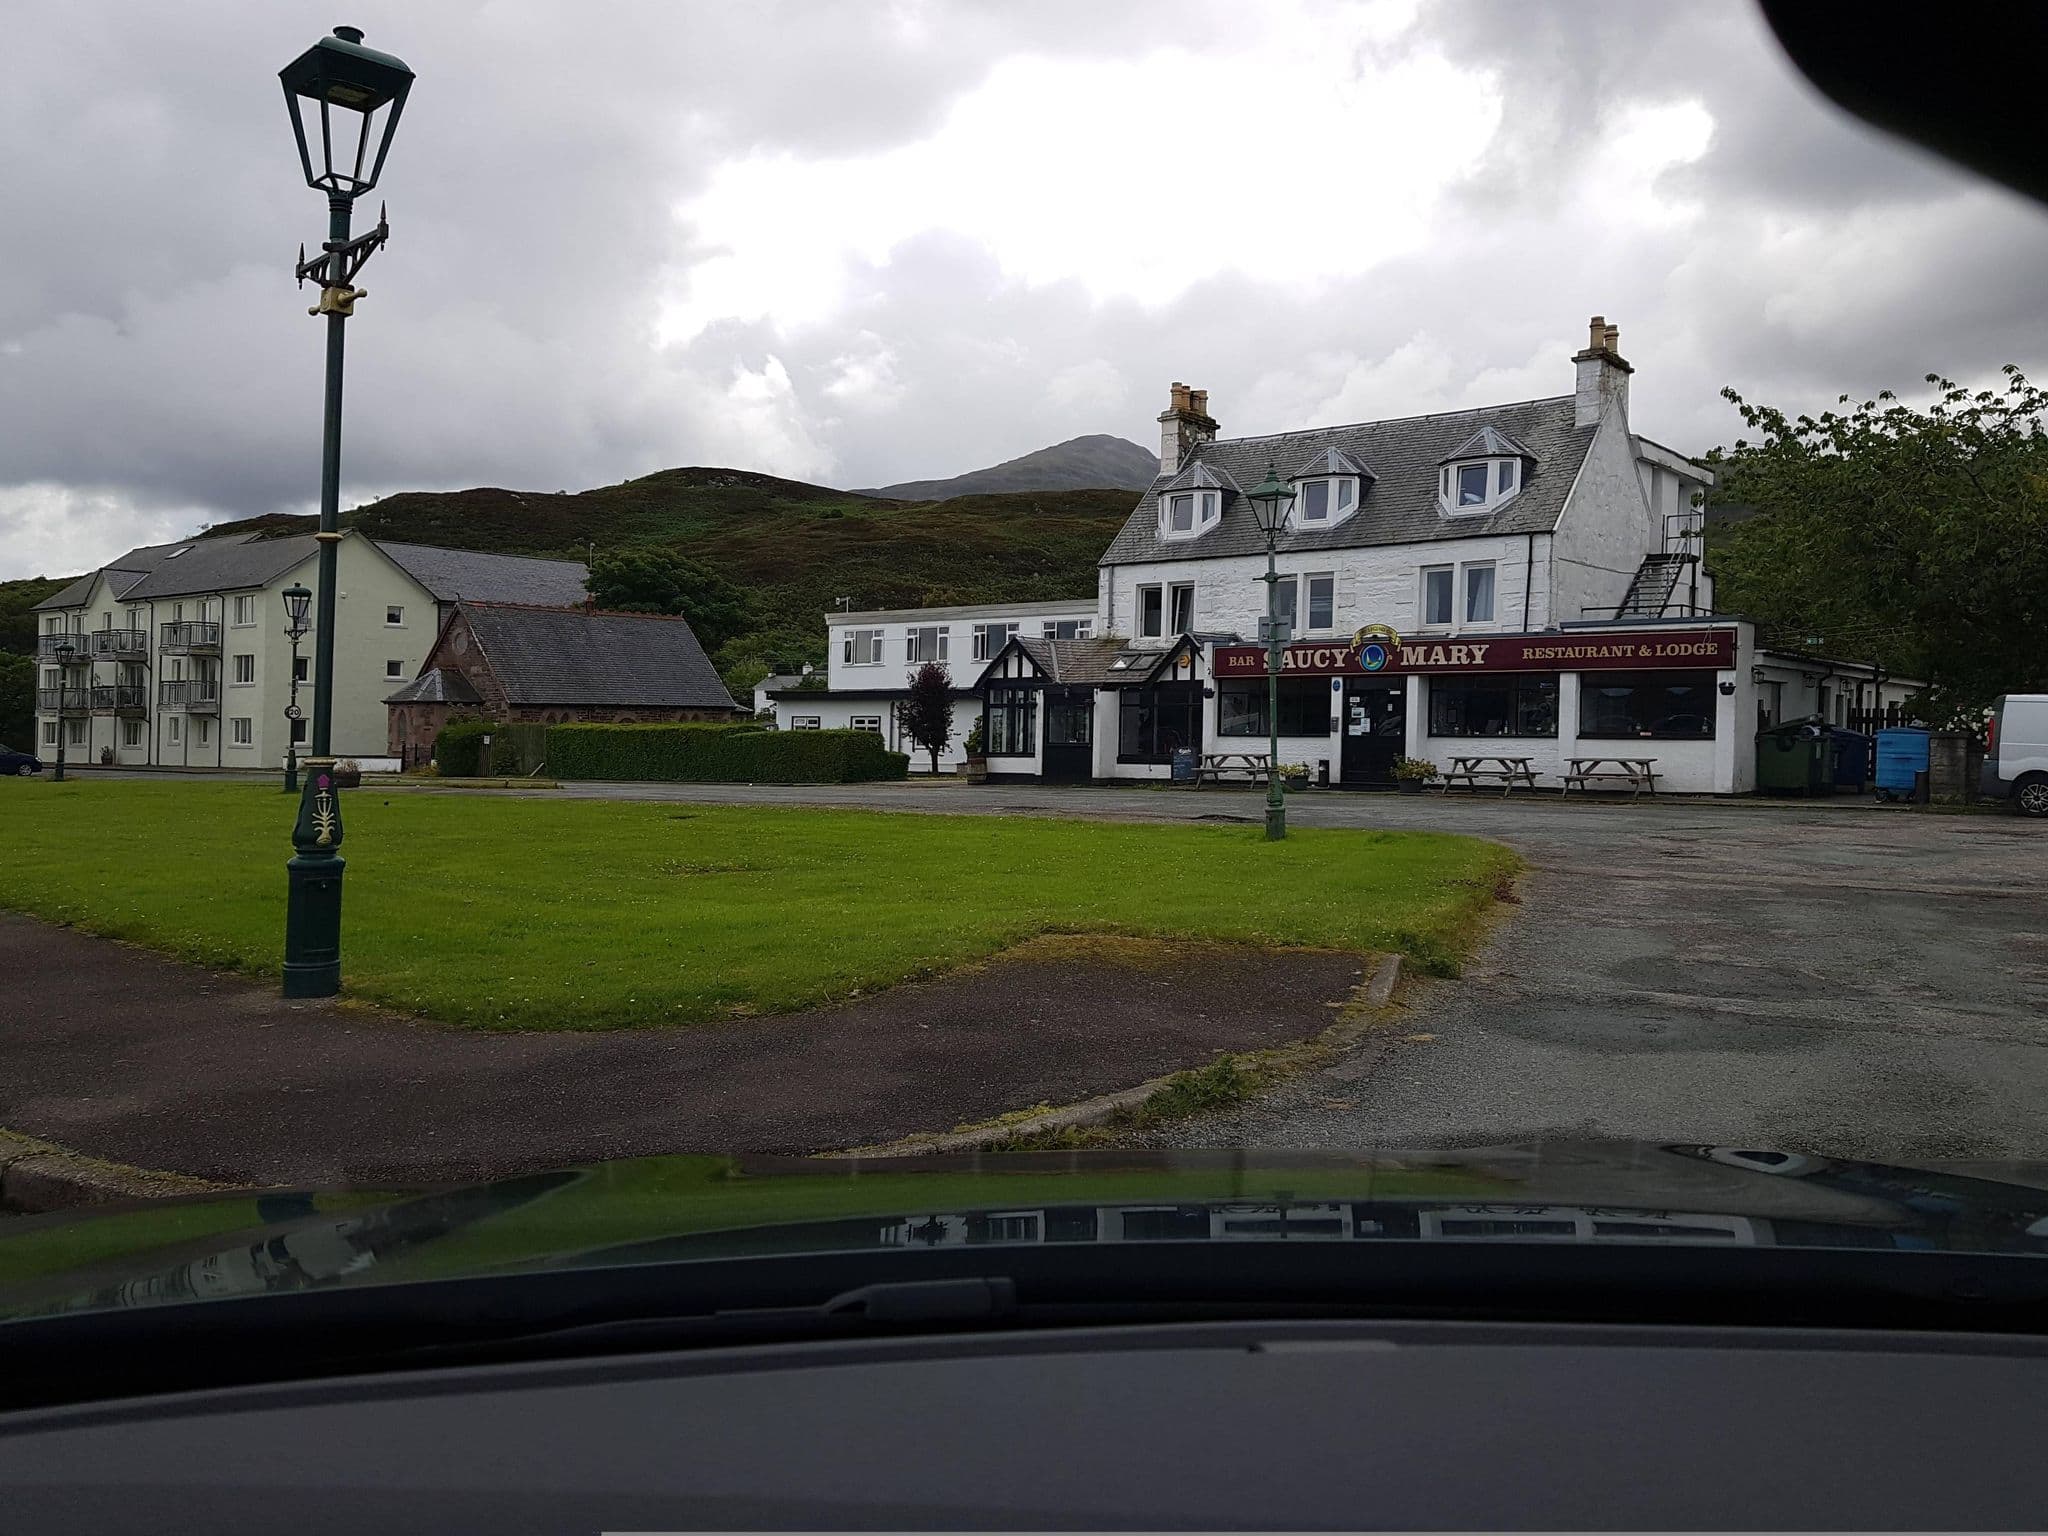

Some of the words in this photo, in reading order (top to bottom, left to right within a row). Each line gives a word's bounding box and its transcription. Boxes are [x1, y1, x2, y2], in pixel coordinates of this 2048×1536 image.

[1400, 644, 1490, 666] MARY
[1522, 645, 1635, 660] RESTAURANT
[1638, 644, 1653, 657] &
[1655, 642, 1719, 657] LODGE
[1228, 655, 1255, 667] BAR
